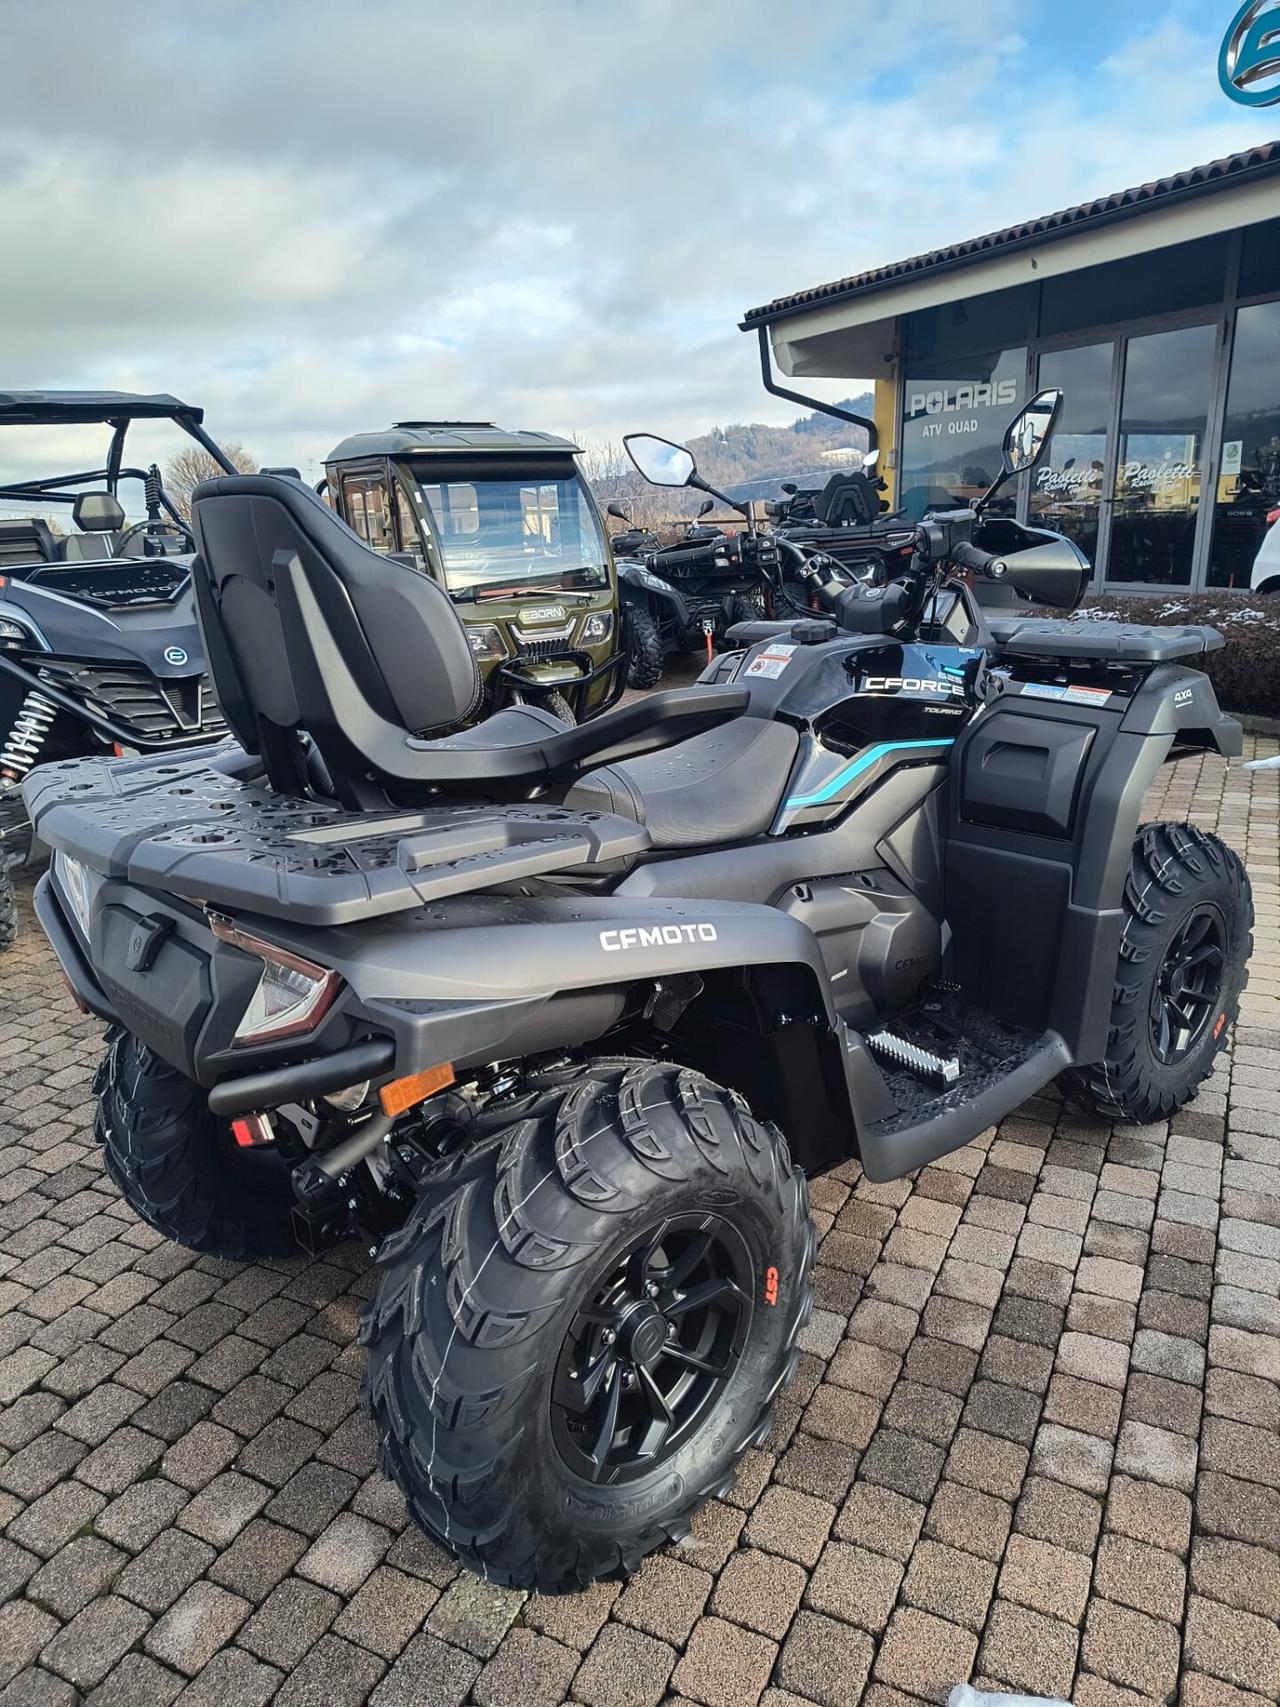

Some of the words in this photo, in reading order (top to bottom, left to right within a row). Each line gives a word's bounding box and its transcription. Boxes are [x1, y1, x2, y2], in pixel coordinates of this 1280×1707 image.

[910, 379, 1017, 417] POLARIS
[922, 423, 942, 438] ATV
[948, 419, 978, 434] QUAD
[1036, 466, 1098, 486] Paoletti
[1123, 461, 1195, 481] Paoletti
[92, 586, 172, 597] CFMOTO
[865, 677, 965, 697] CFORCE
[599, 923, 718, 952] CFMOTO
[765, 1266, 779, 1306] CST
